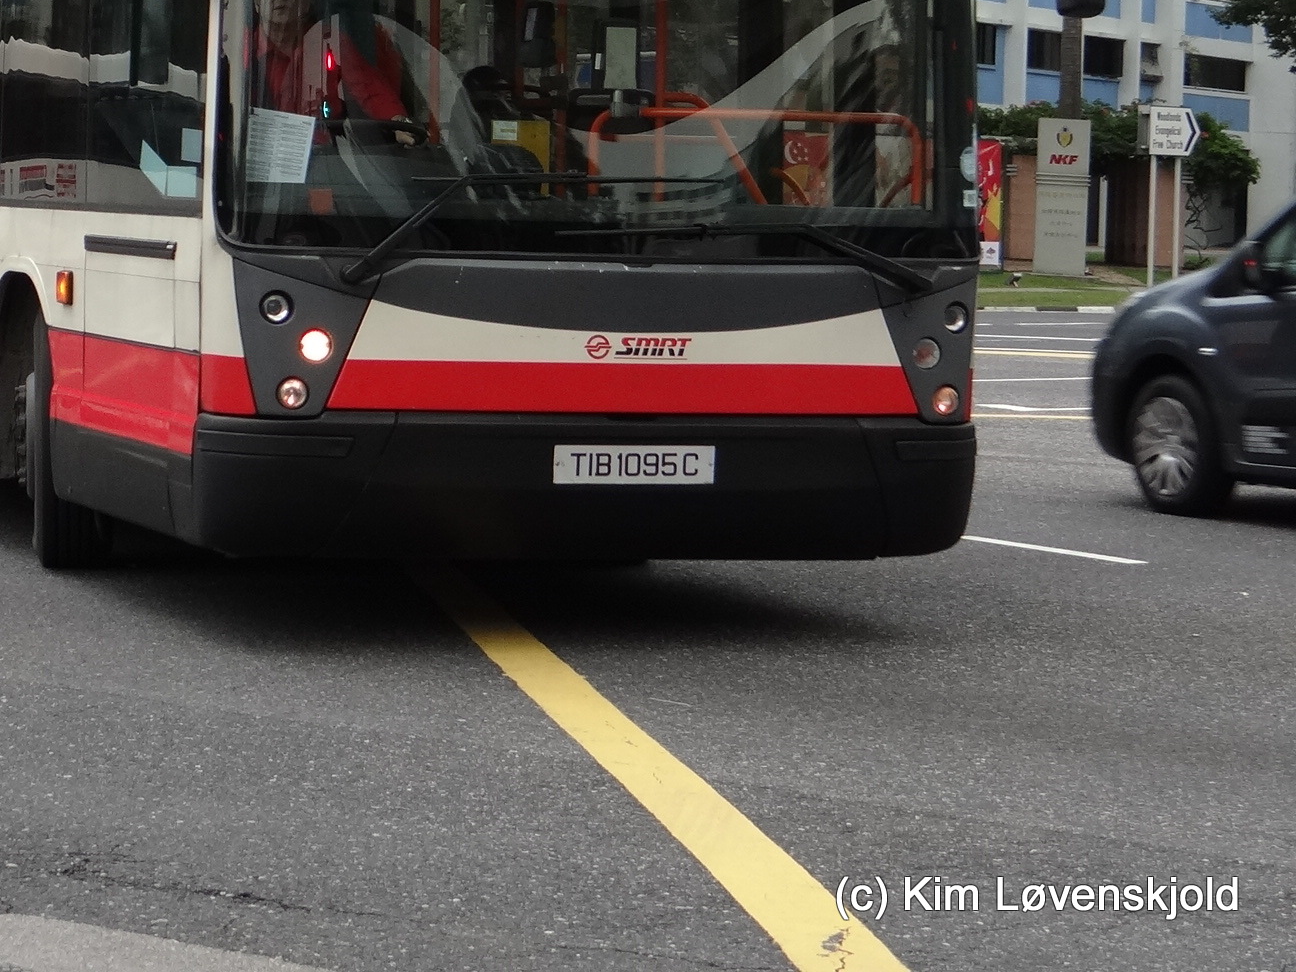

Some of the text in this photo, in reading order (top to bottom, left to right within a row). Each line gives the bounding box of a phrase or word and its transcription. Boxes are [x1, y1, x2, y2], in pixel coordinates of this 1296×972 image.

[1049, 154, 1080, 165] NKF
[614, 337, 691, 356] SMRT
[571, 452, 699, 477] TIB1095C
